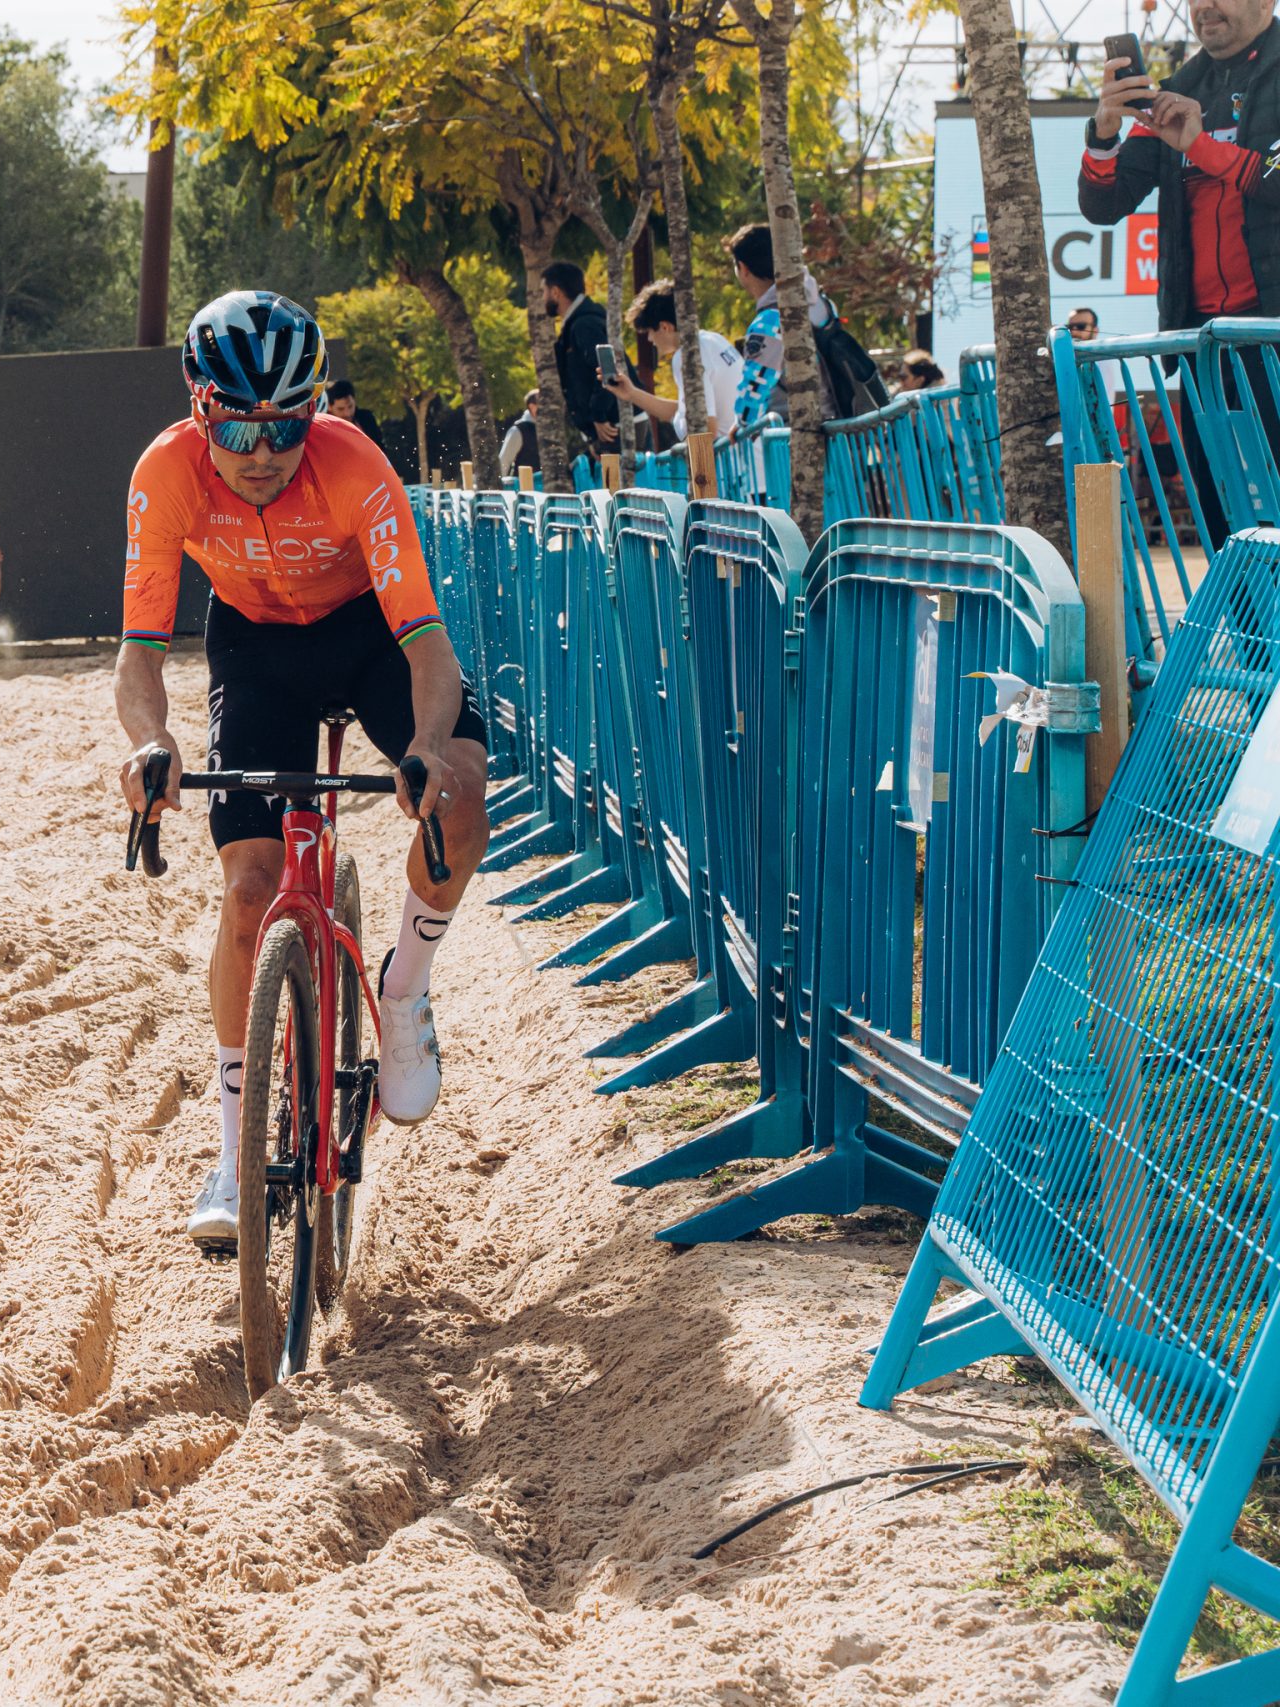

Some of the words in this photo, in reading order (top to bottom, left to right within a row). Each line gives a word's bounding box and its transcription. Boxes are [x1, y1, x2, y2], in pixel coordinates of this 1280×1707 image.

[1051, 230, 1113, 280] CI
[1137, 228, 1158, 251] C
[124, 485, 149, 590] INEOS
[210, 513, 244, 526] GOBIK
[362, 481, 402, 592] INEOS
[203, 536, 341, 561] INEOS
